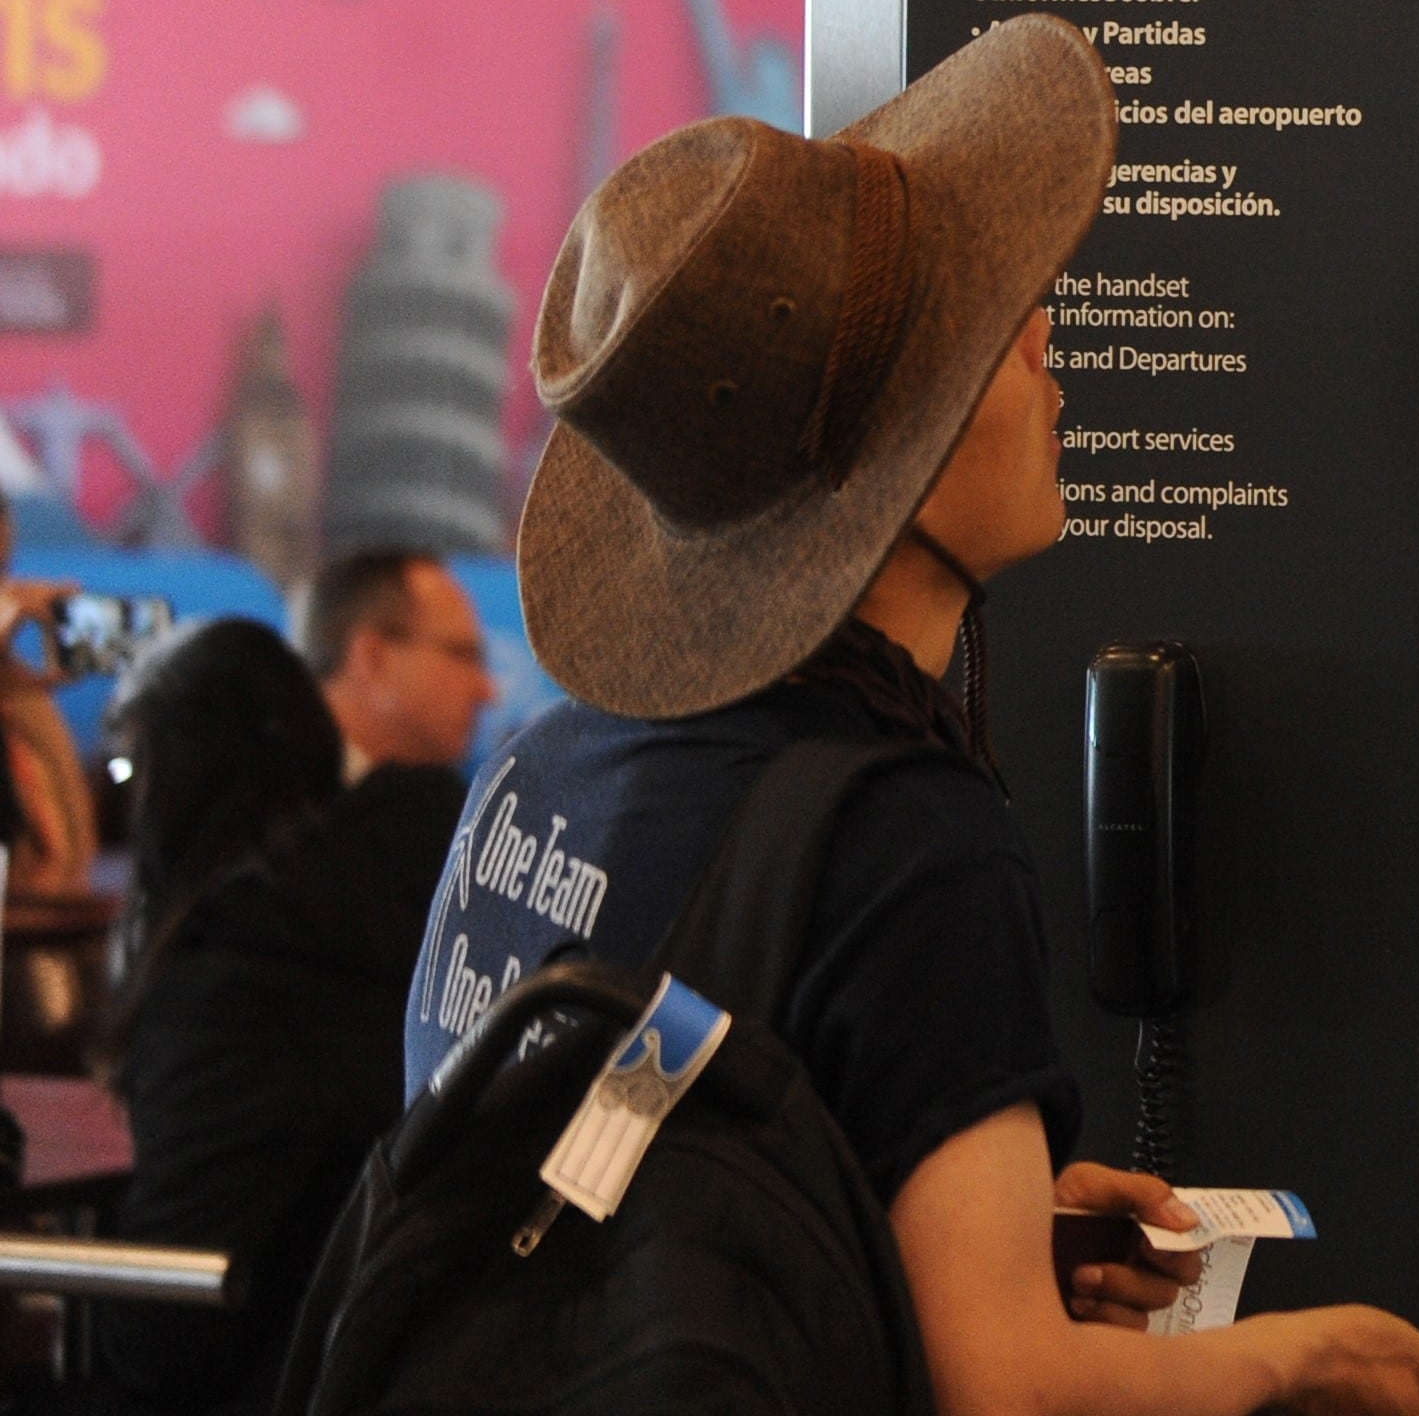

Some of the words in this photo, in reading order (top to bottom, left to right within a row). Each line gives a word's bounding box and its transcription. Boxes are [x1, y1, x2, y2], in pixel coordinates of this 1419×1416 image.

[1104, 21, 1206, 45] Partidas
[1175, 100, 1213, 124] del
[1219, 105, 1361, 131] aeropuerto
[1222, 166, 1237, 189] y
[1103, 197, 1130, 214] su
[1136, 193, 1280, 220] disposición.
[1054, 271, 1091, 296] the
[1097, 272, 1189, 298] handset
[1060, 302, 1193, 328] information
[1199, 311, 1234, 328] on:
[1069, 345, 1113, 369] and
[1120, 346, 1246, 376] Departures
[1062, 425, 1140, 454] airport
[1145, 428, 1234, 452] services
[1111, 479, 1154, 503] and
[1161, 481, 1288, 510] complaints
[1057, 518, 1109, 541] your
[1114, 513, 1212, 543] disposal.
[475, 791, 537, 902] One
[526, 814, 608, 940] Team
